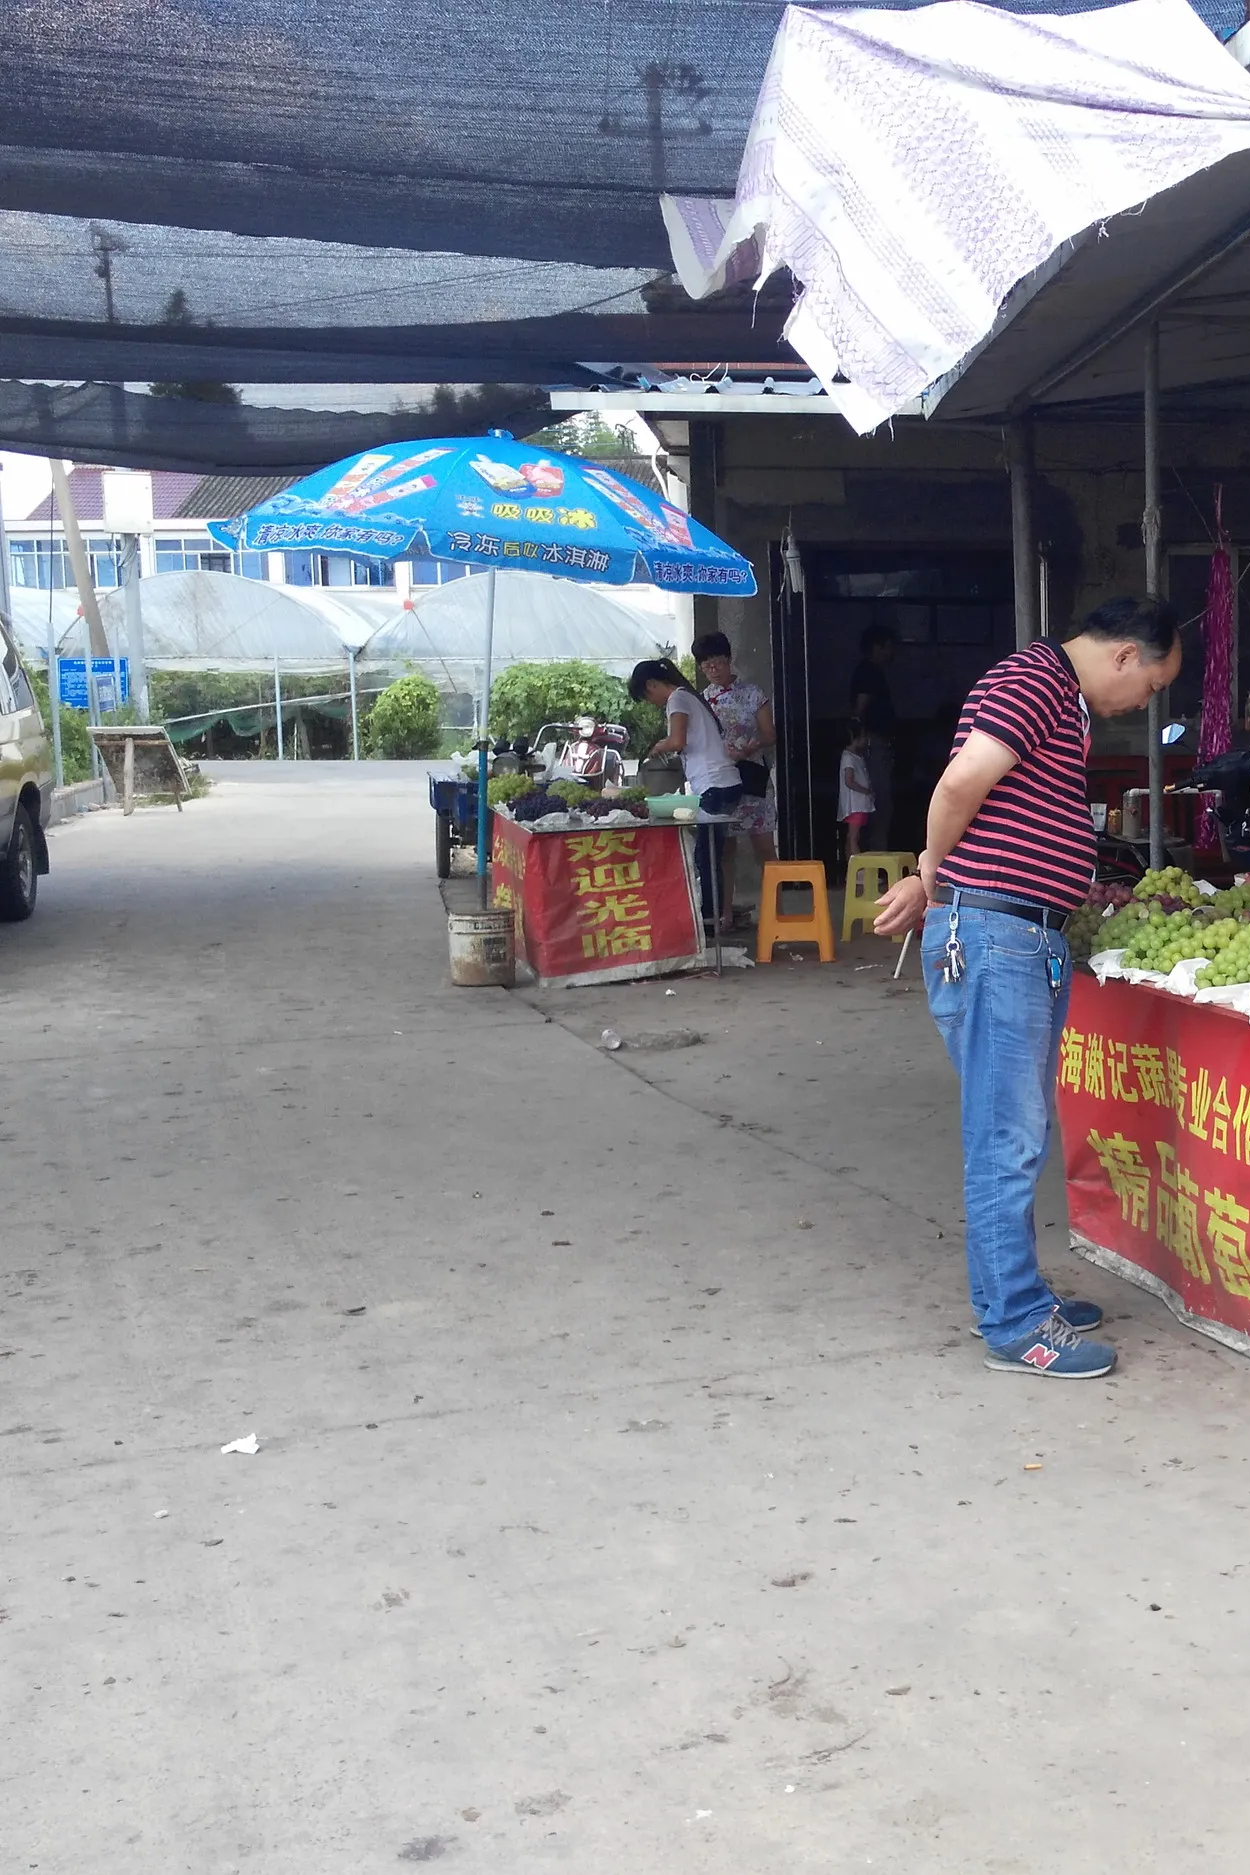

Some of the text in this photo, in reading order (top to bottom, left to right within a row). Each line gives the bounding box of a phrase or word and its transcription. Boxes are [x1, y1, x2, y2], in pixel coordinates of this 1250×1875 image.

[491, 502, 597, 530] 吸吸冰
[564, 830, 653, 959] 欢迎光临
[1021, 1342, 1060, 1370] N
